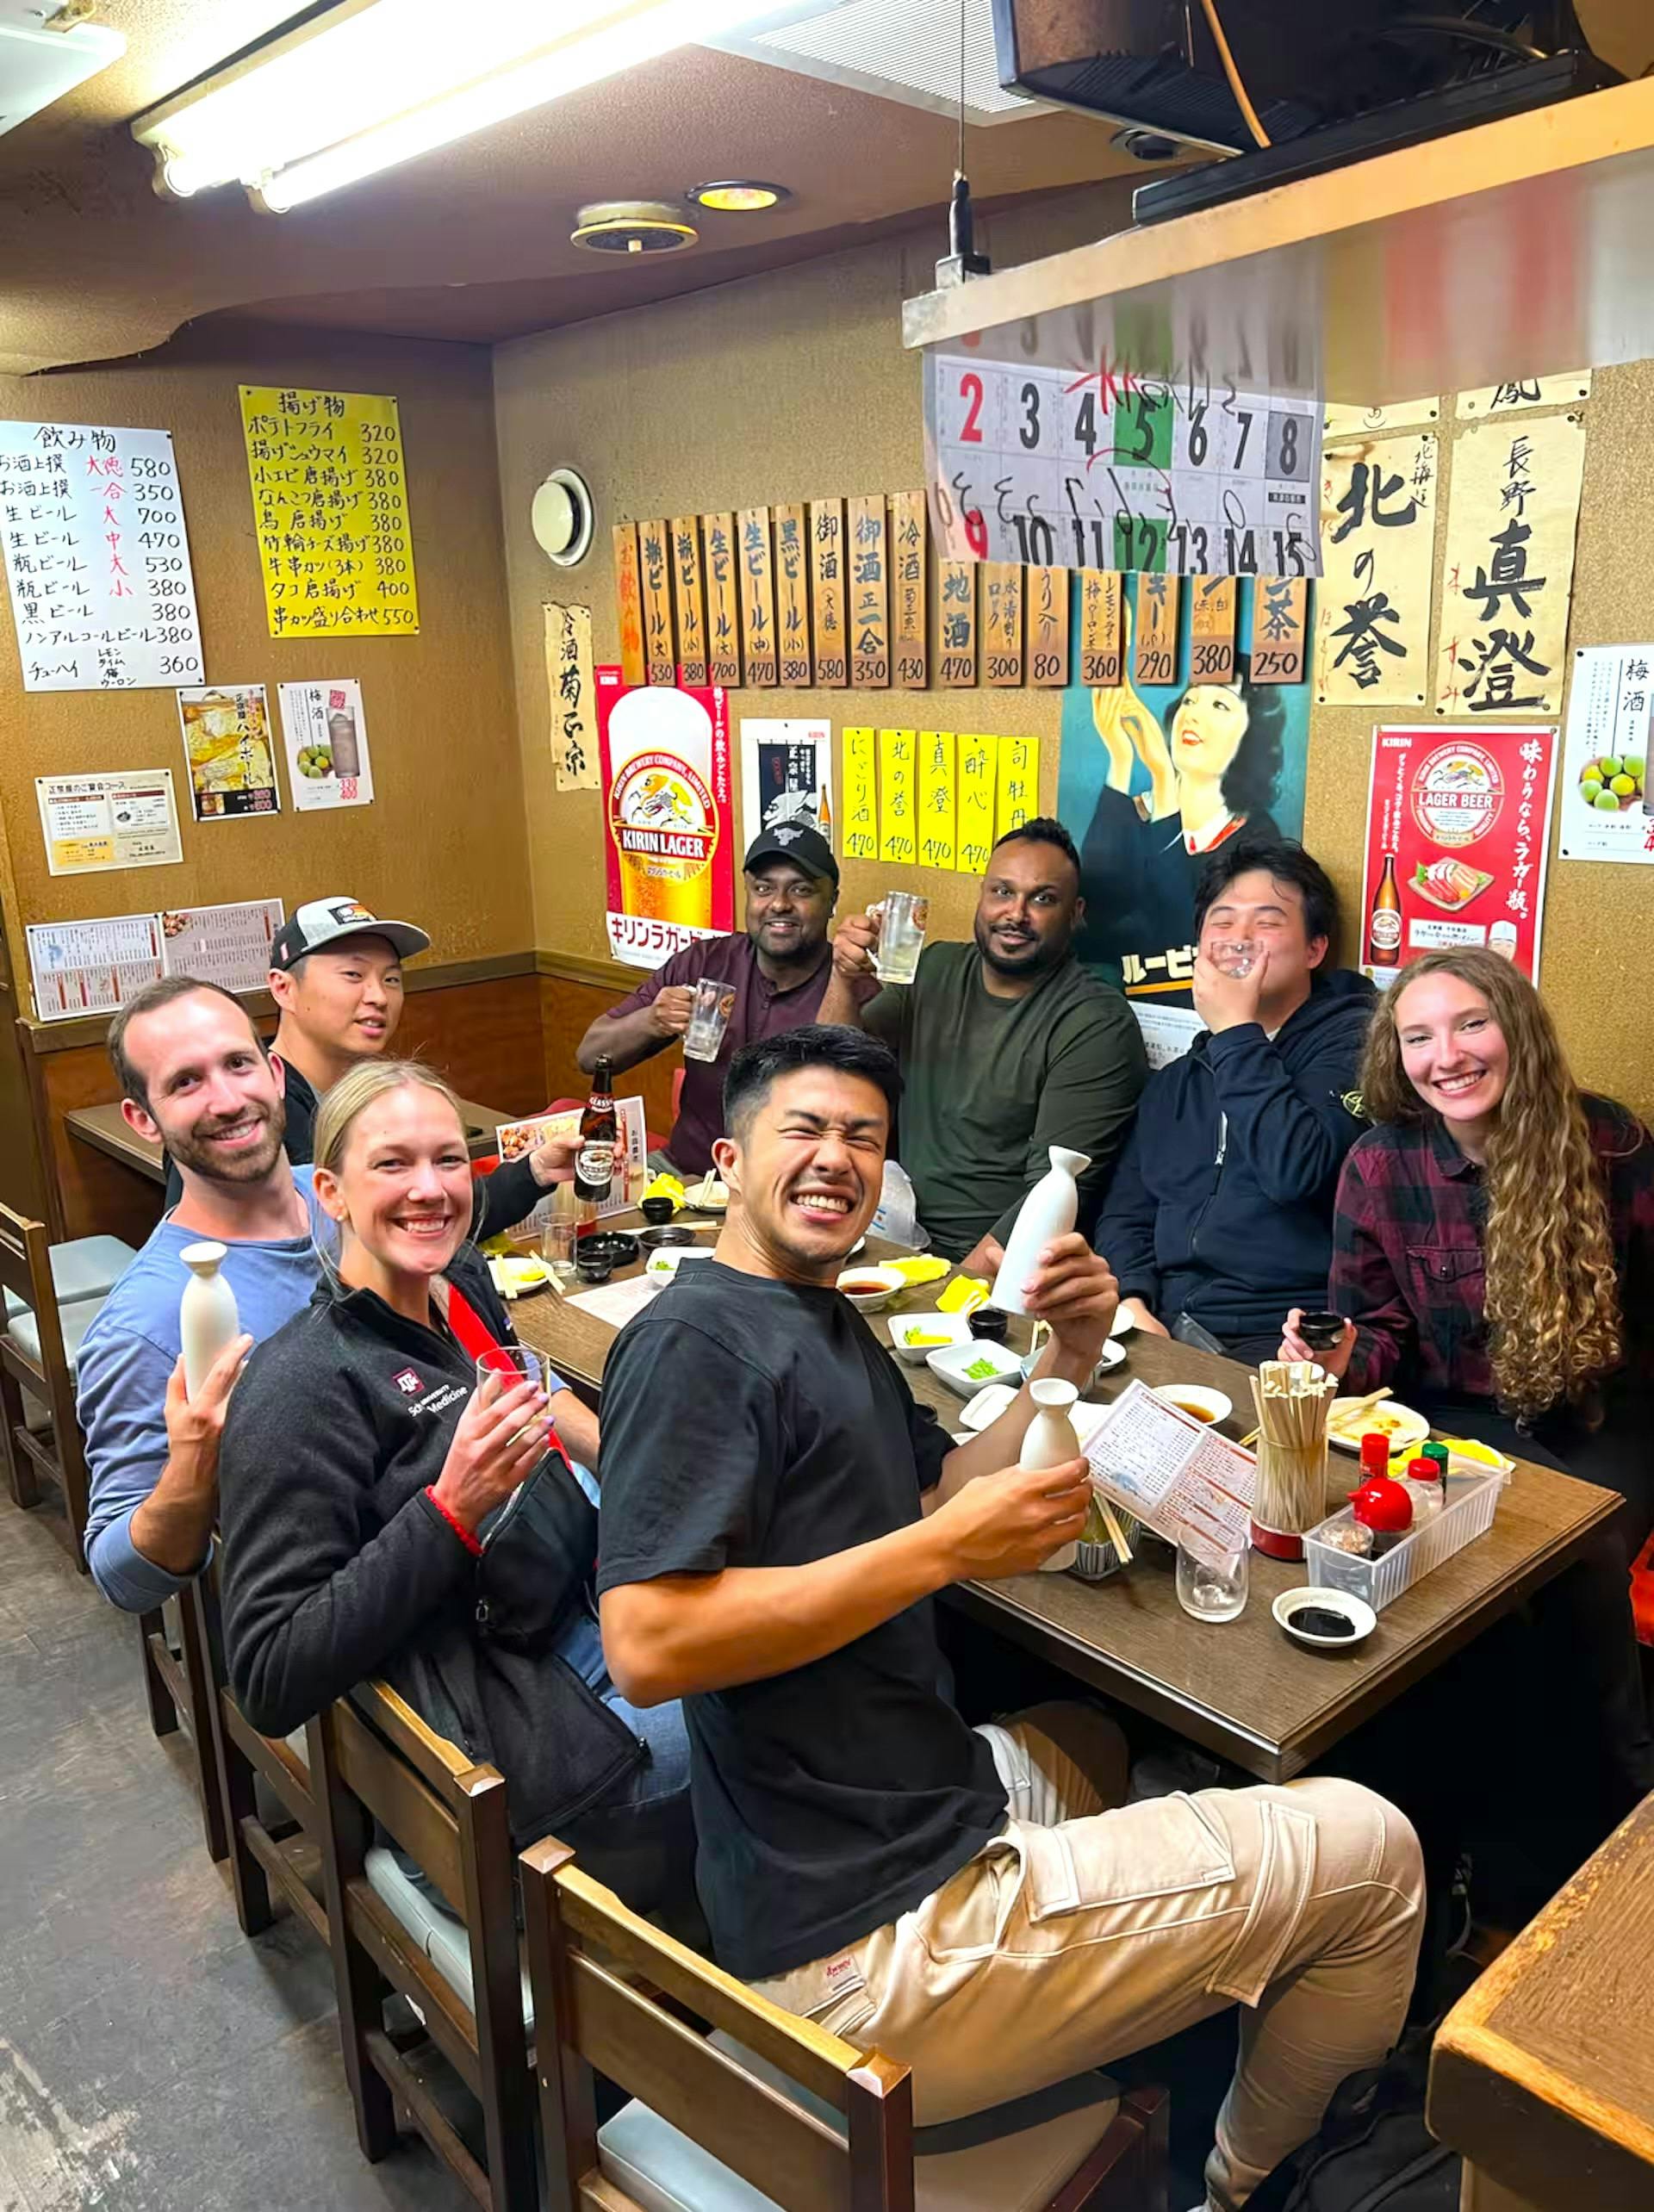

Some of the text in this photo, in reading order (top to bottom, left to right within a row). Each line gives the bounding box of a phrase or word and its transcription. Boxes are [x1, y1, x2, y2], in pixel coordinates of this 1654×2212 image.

[279, 391, 345, 418] 揚げ物
[248, 415, 396, 443] ポテトフライ 320
[960, 372, 1297, 475] 2 3 4 5 6 7 8
[34, 426, 116, 453] 飲み物
[362, 447, 399, 465] 320
[131, 457, 171, 478] 580
[365, 469, 399, 488] 380
[90, 482, 127, 500] 一合
[134, 483, 173, 501] 350
[368, 492, 401, 511] 380
[103, 506, 120, 525] 大
[138, 508, 177, 525] 700
[371, 513, 401, 532] 380
[105, 531, 121, 550] 中
[138, 532, 180, 550] 470
[372, 535, 404, 554] 380
[965, 509, 1305, 577] 9 10 11 12 13 14 15
[13, 553, 183, 575] 瓶ビール 大 530
[376, 558, 406, 575] 380
[1330, 462, 1416, 689] 北の誉
[16, 579, 186, 599] 瓶ビール 小 380
[376, 581, 409, 599] 400
[22, 602, 190, 624] 黒ビール 380
[382, 609, 414, 624] 550
[26, 626, 192, 645] ノンアルコールビール 380
[28, 660, 78, 680] チューハイ
[159, 656, 199, 674] 360
[898, 659, 923, 680] 430
[941, 656, 972, 680] 470
[987, 656, 1018, 679] 300
[1034, 653, 1060, 679] 80
[1084, 656, 1116, 680] 360
[1137, 650, 1171, 679] 290
[1193, 644, 1231, 675] 380
[1254, 652, 1298, 676] 250
[651, 663, 672, 682] 530
[684, 662, 703, 680] 380
[713, 662, 736, 680] 700
[748, 662, 774, 682] 470
[783, 662, 806, 680] 380
[818, 660, 843, 680] 580
[855, 662, 885, 680] 350
[1623, 659, 1649, 712] 梅酒
[1382, 737, 1413, 748] KIRIN
[1419, 792, 1493, 808] LAGER BEER
[622, 830, 705, 858] KIRIN LAGER
[847, 832, 874, 854] 470
[885, 836, 912, 857] 470
[923, 838, 951, 861] 470
[961, 844, 989, 864] 470
